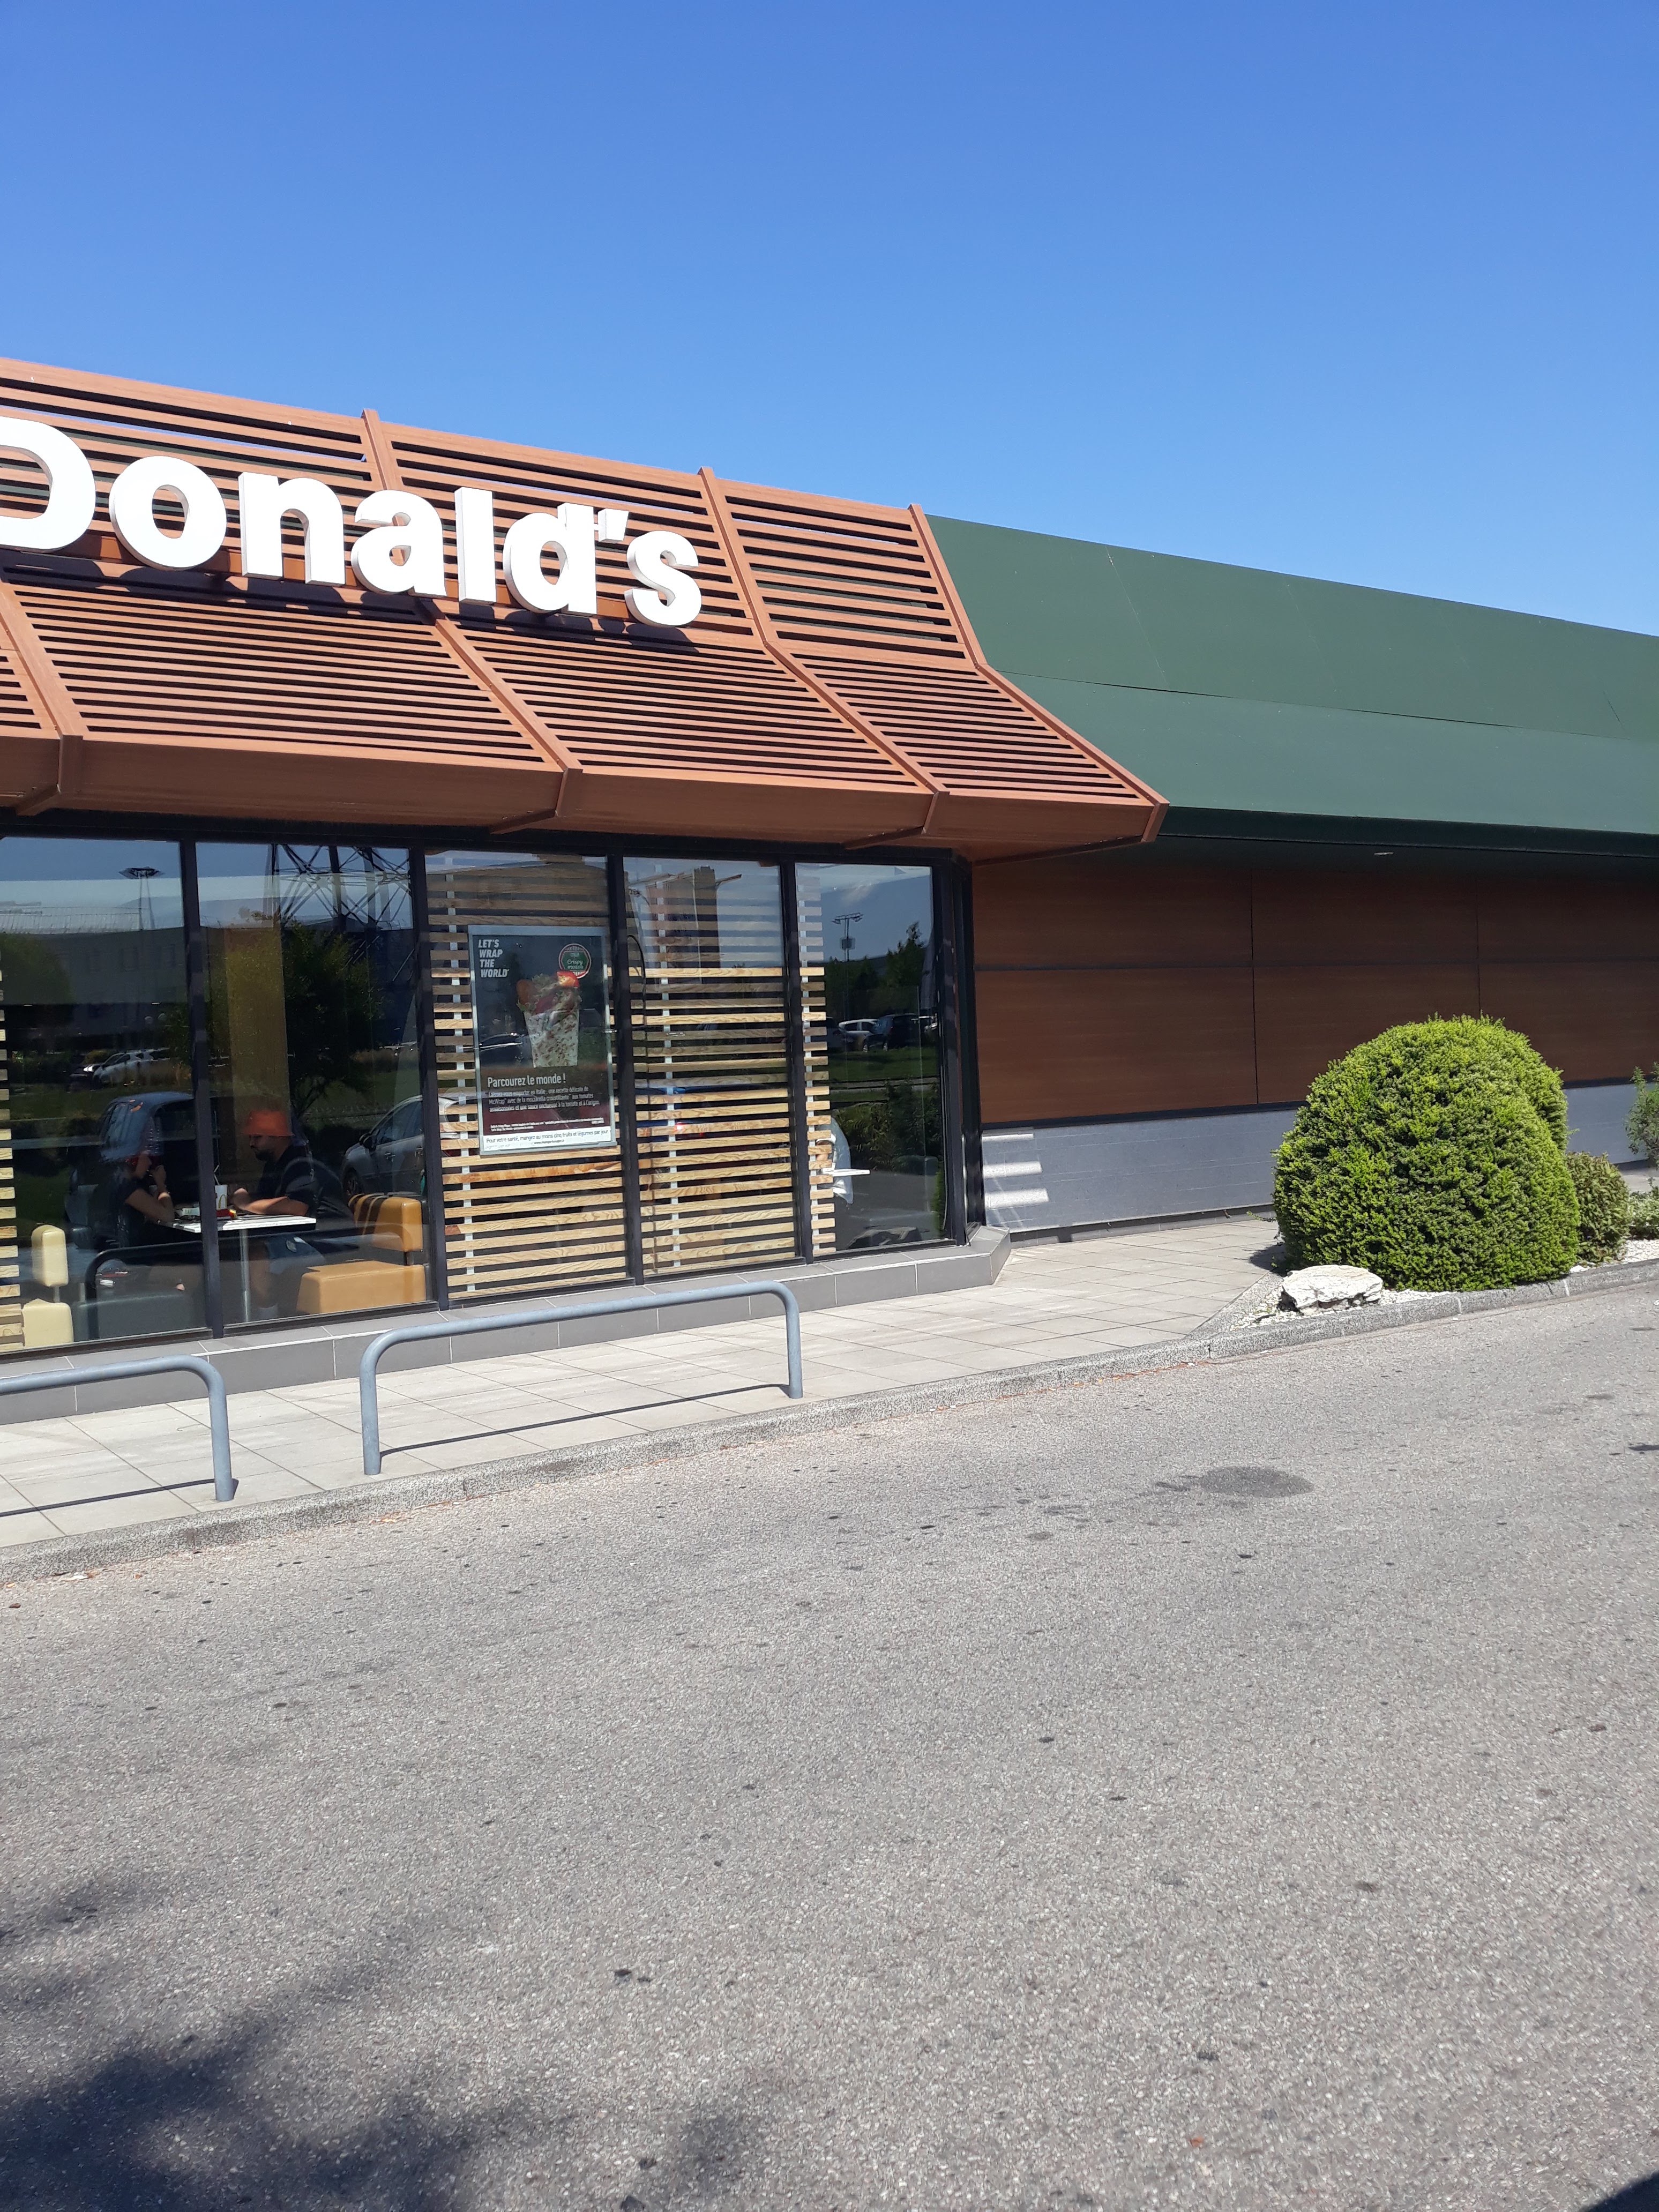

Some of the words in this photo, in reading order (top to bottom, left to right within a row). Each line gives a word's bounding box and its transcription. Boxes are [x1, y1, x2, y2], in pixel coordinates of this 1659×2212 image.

[478, 939, 500, 948] LET'S
[479, 949, 503, 958] WRAP
[480, 959, 495, 968] THE
[487, 1077, 526, 1088] Parcourez
[527, 1075, 535, 1085] le
[536, 1073, 562, 1085] monde
[563, 1073, 566, 1083] !
